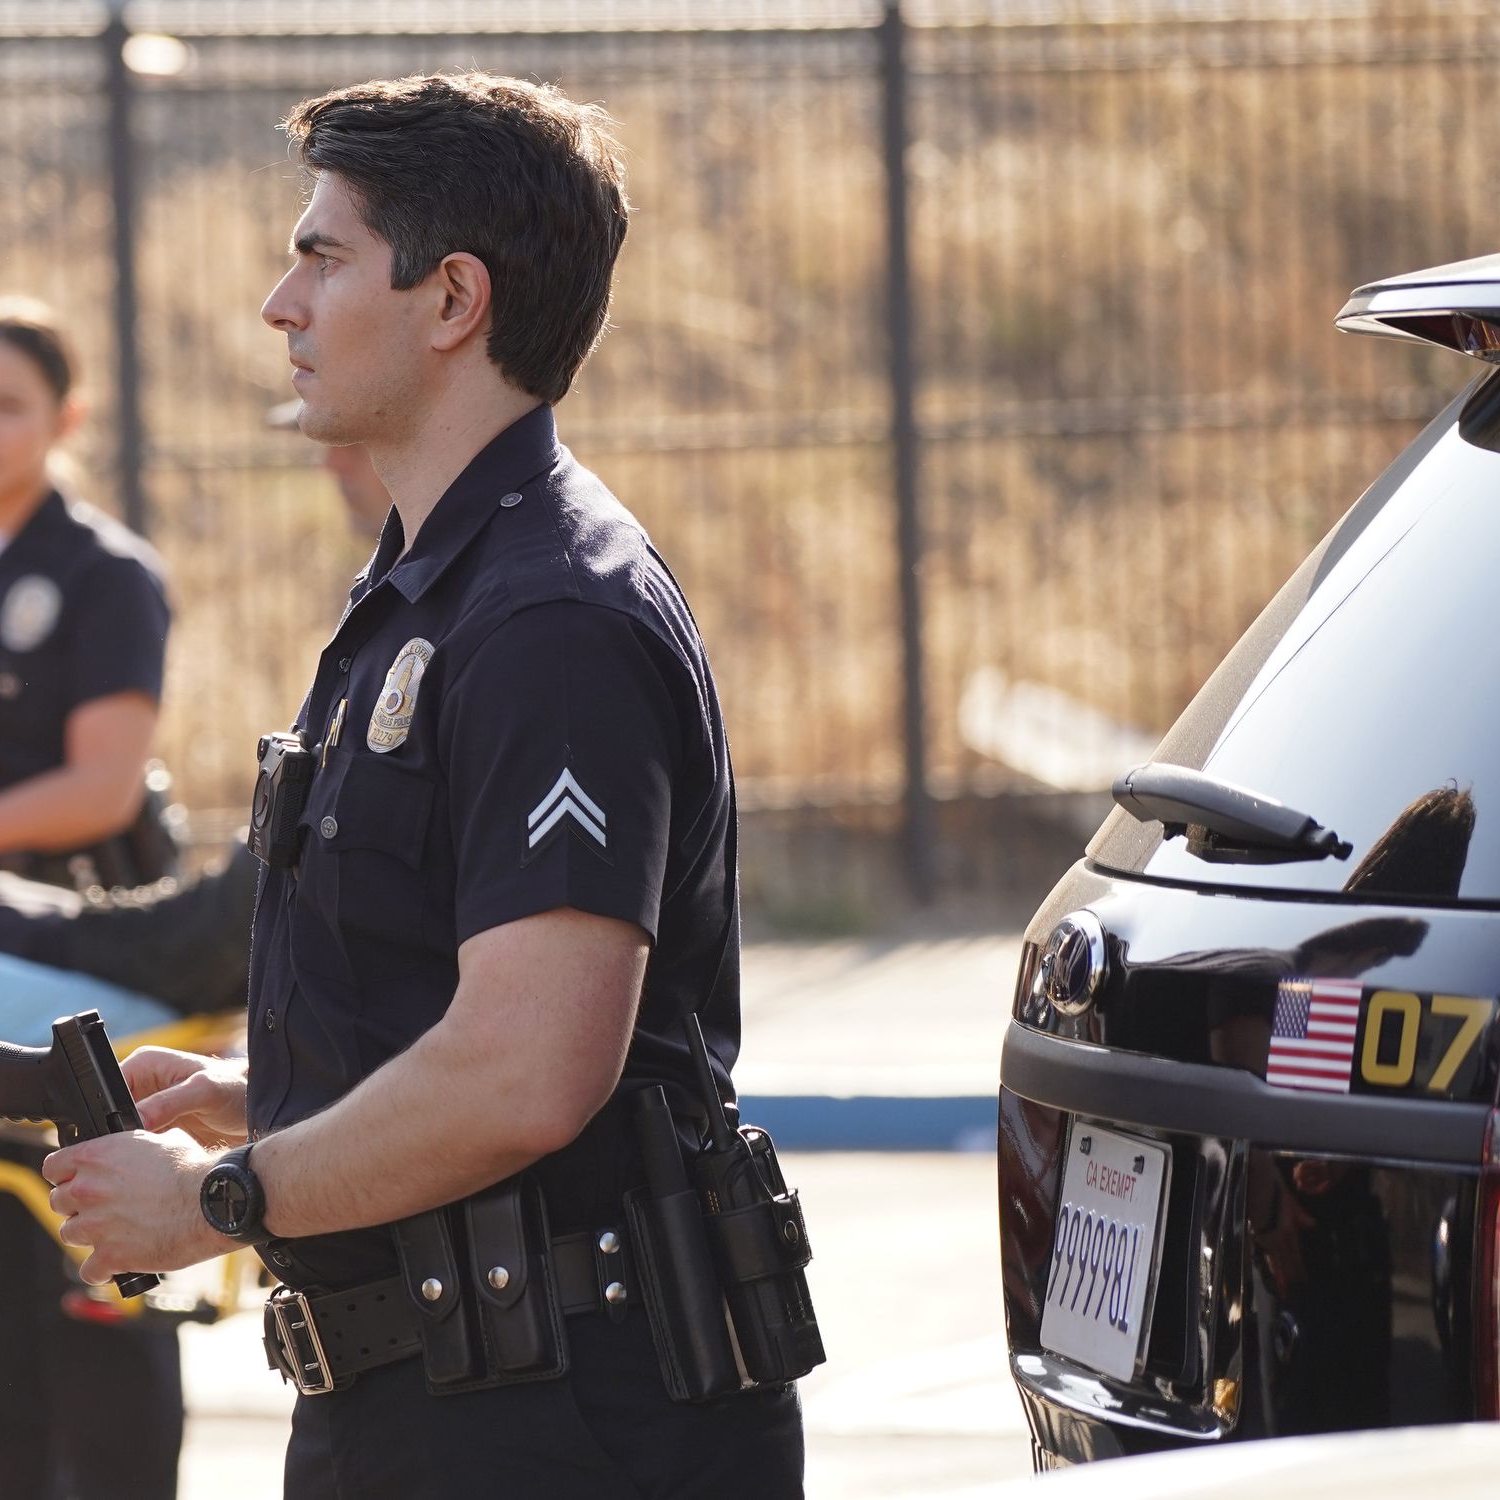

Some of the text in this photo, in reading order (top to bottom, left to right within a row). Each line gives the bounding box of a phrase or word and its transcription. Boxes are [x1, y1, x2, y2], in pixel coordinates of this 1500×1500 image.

[1360, 990, 1493, 1092] 07
[1086, 1159, 1137, 1203] CA EXEMPT
[1047, 1205, 1139, 1334] 9999981
